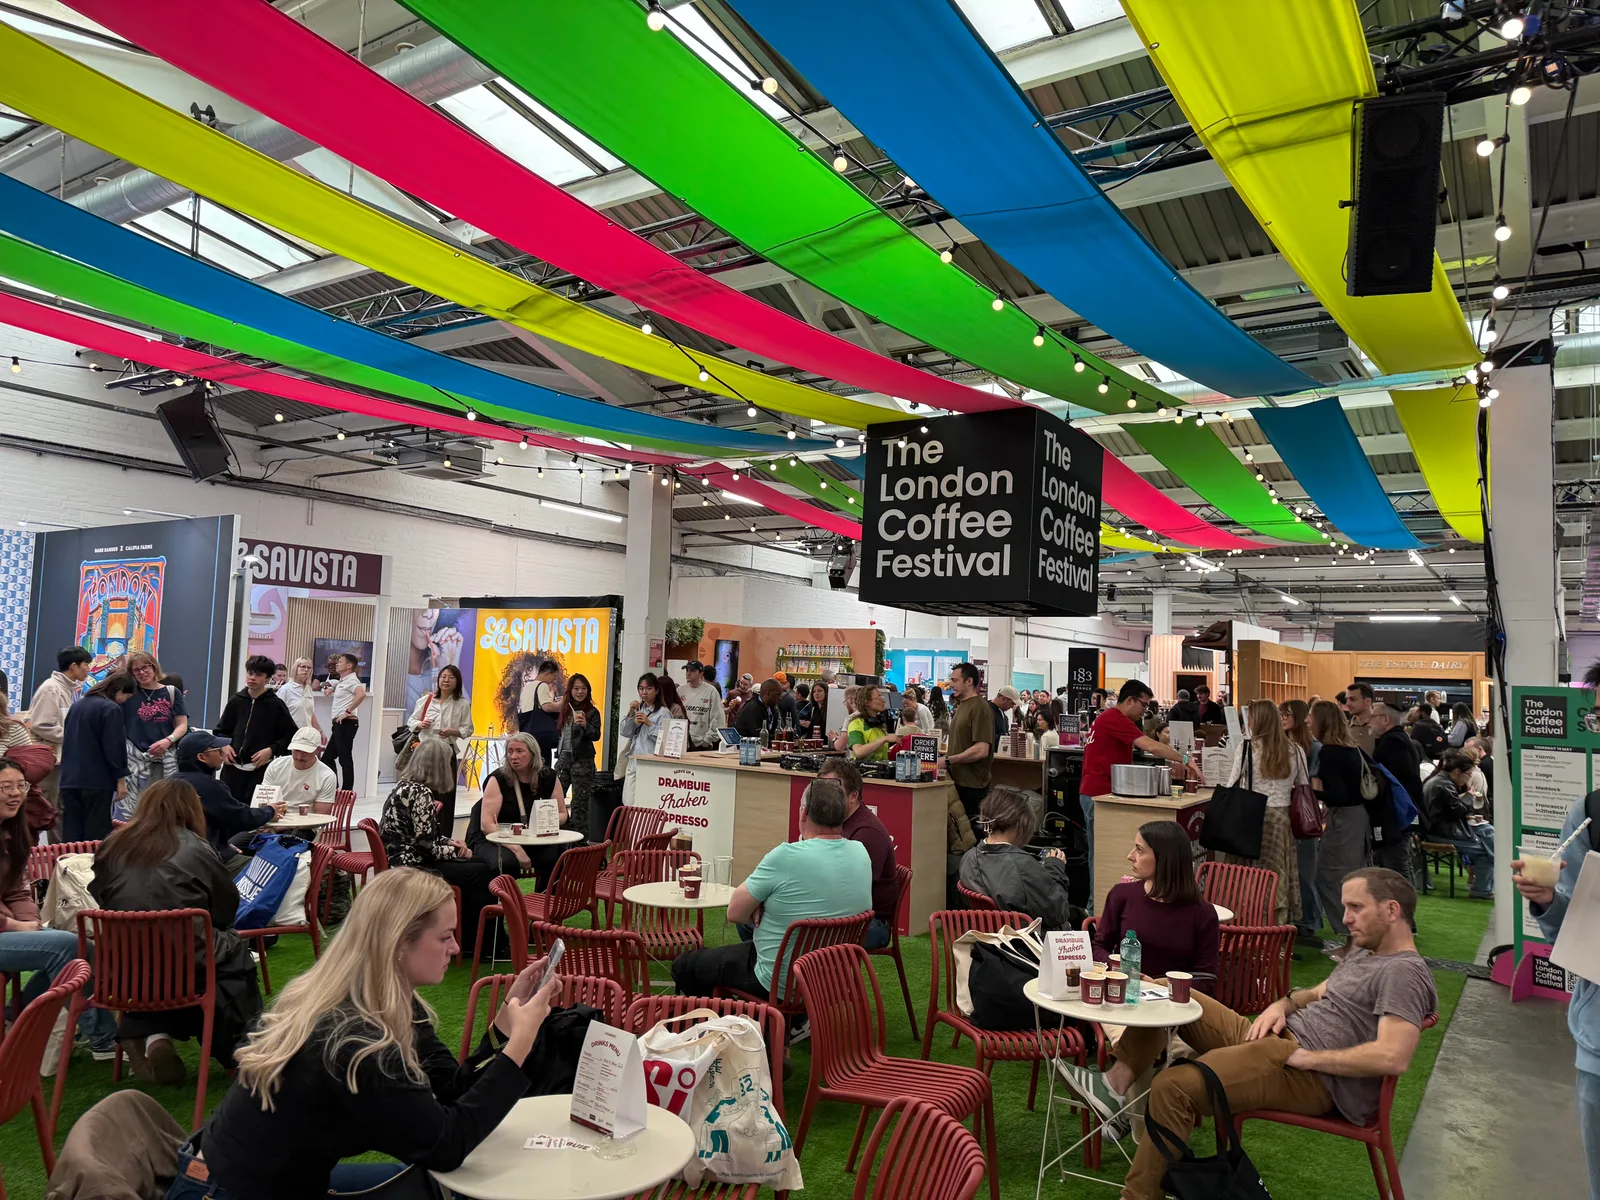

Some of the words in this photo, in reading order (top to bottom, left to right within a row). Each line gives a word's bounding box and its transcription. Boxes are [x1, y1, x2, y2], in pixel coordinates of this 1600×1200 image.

[882, 436, 943, 467] The
[1043, 429, 1071, 471] The
[880, 466, 1013, 502] London
[1041, 466, 1096, 518] London
[877, 502, 1013, 542] Coffee
[1040, 506, 1094, 557] Coffee
[252, 544, 358, 588] SAVISTA
[875, 544, 1011, 578] Festival
[1038, 547, 1093, 593] Festival
[88, 568, 154, 614] LONDON
[509, 617, 600, 654] SAVISTA
[1386, 660, 1427, 669] ESTATE
[1430, 660, 1466, 669] DAIRY
[1524, 700, 1544, 708] The
[1525, 708, 1563, 716] London
[1525, 716, 1563, 726] Coffee
[1525, 726, 1563, 735] Festival
[658, 776, 710, 792] DRAMBUIE
[658, 791, 708, 810] Shaken
[660, 812, 708, 828] PRESSO
[1058, 944, 1084, 954] Shaken
[1536, 965, 1562, 974] London
[1536, 971, 1562, 982] Coffee
[1536, 978, 1562, 988] Festival
[609, 1043, 621, 1056] MENU
